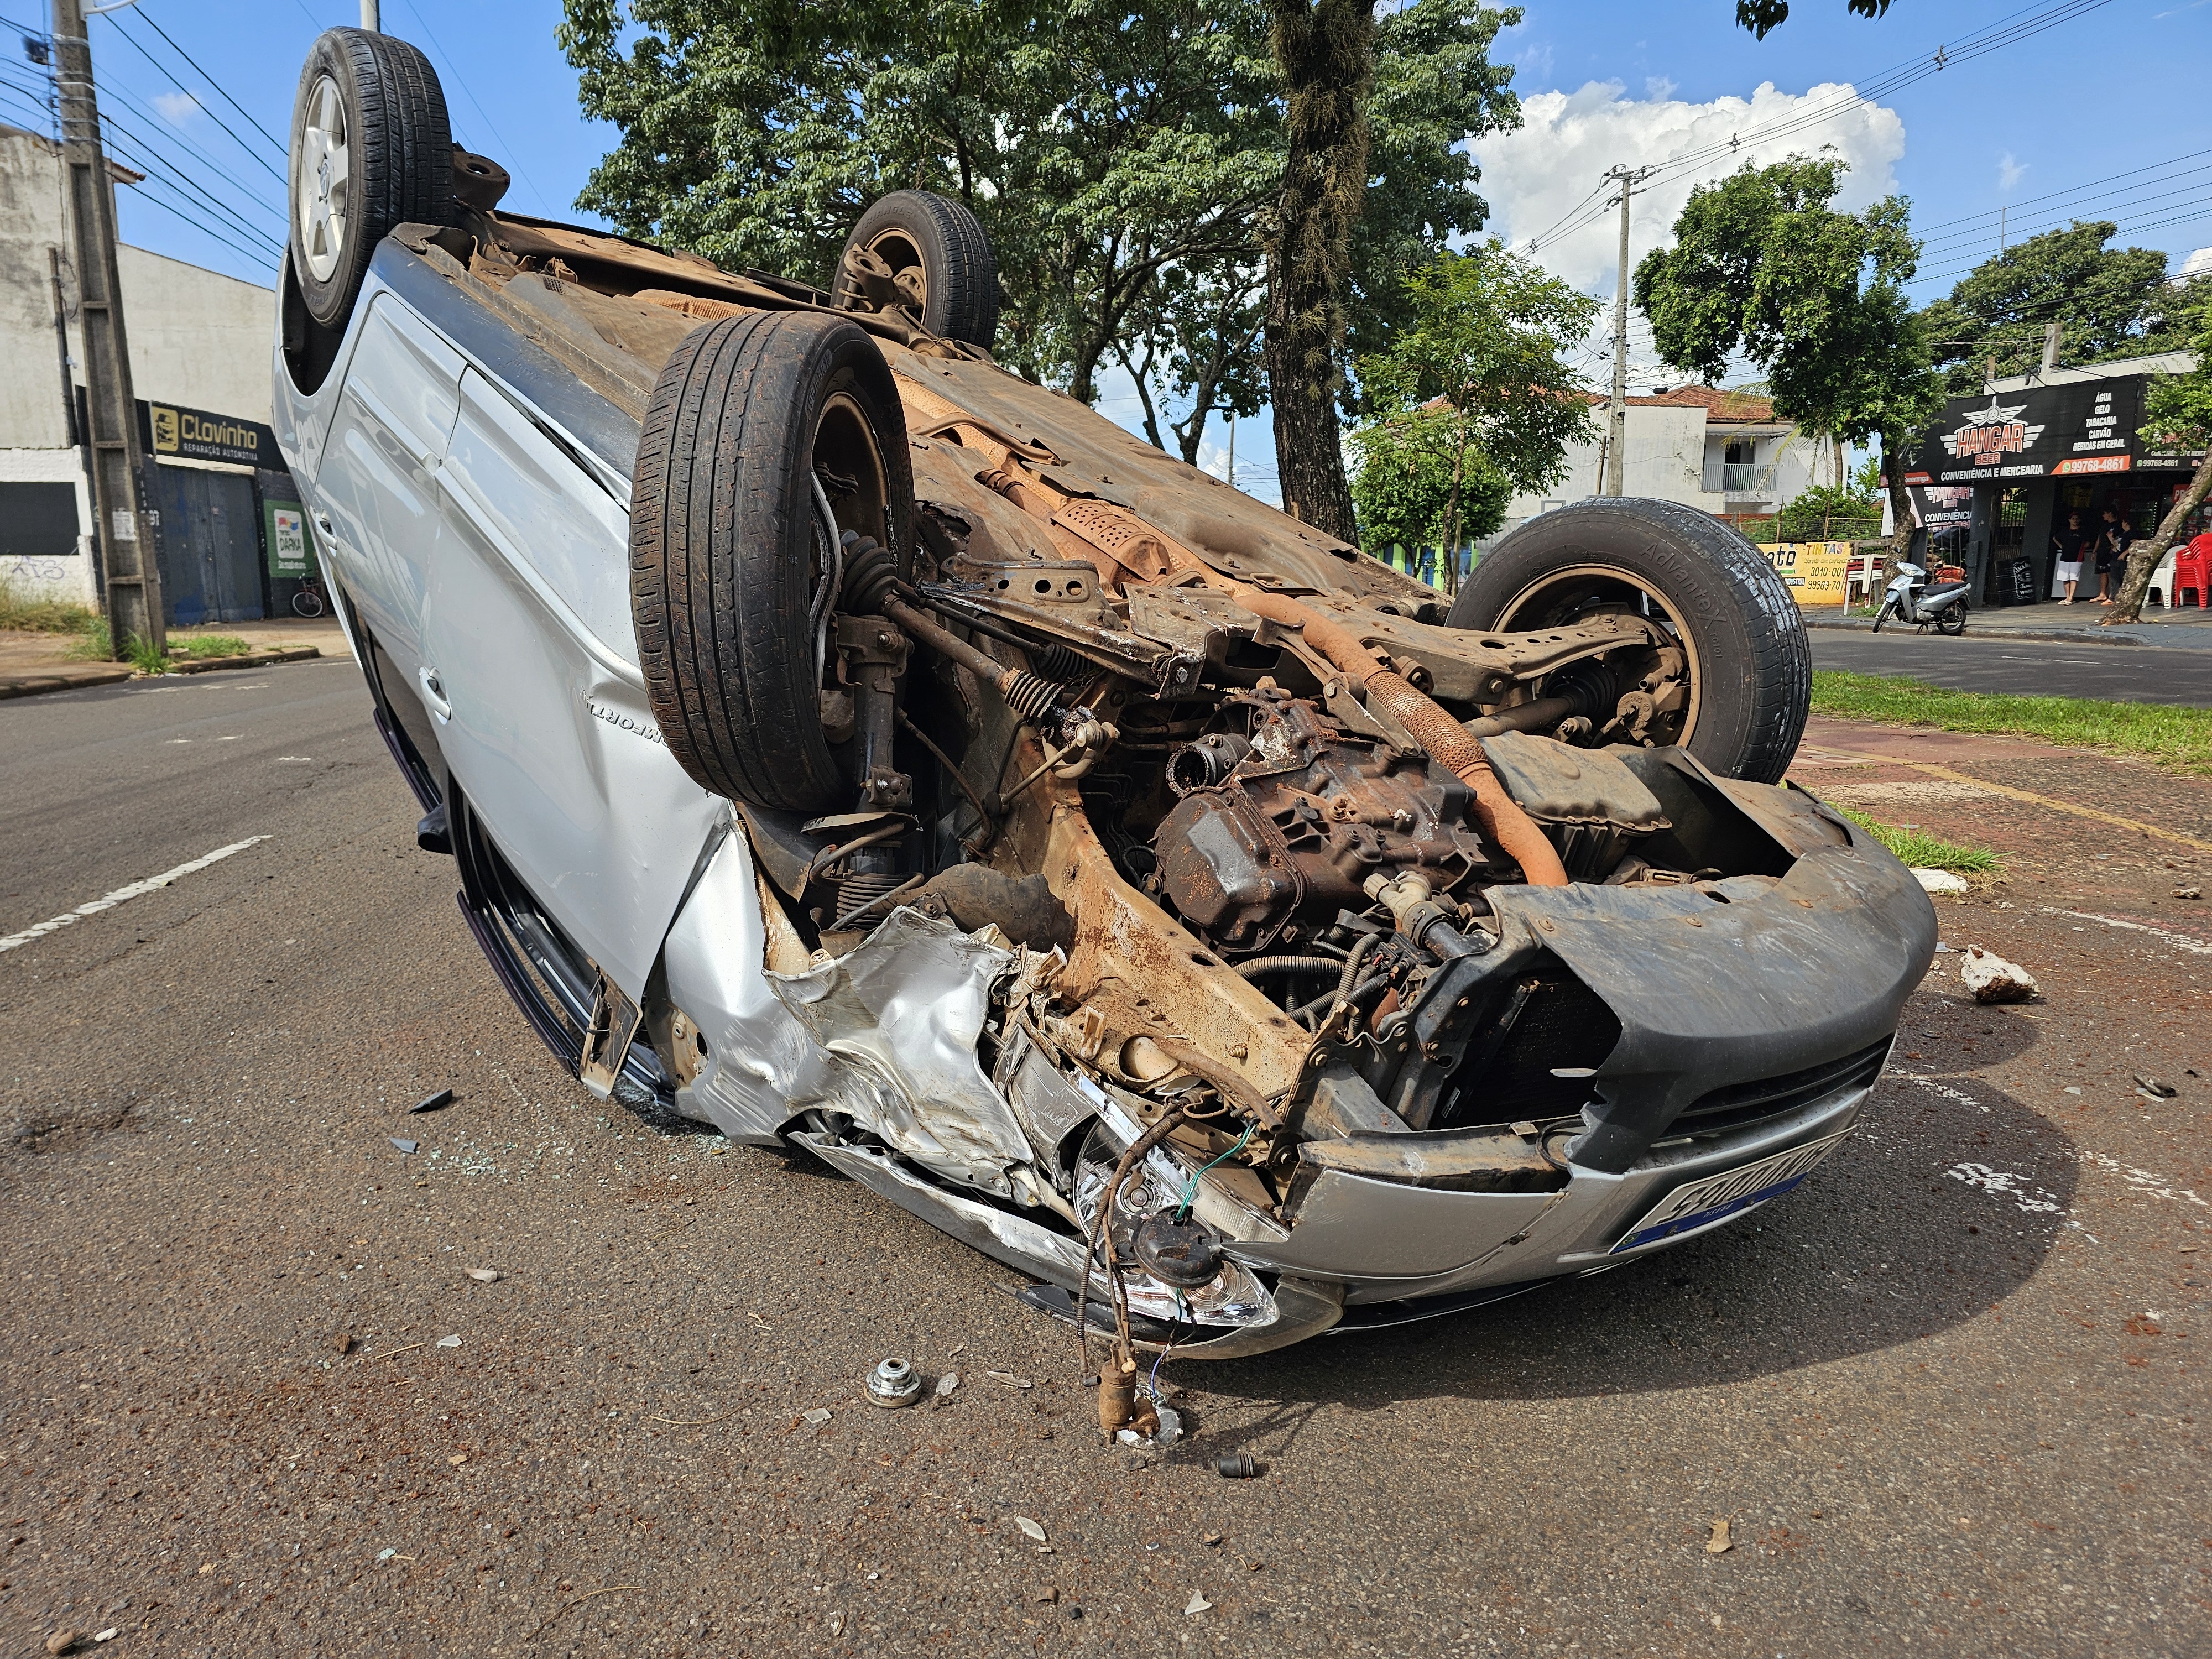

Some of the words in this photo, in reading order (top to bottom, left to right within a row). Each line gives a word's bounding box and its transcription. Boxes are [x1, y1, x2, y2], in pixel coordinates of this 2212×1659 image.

[2095, 392, 2111, 403] ÁGUA
[2094, 404, 2110, 414] GELO
[2086, 416, 2117, 427] TABACARIA
[181, 414, 257, 450] Clovinho
[2088, 427, 2111, 440] CARVÃO
[1956, 424, 2024, 459] HANGAR
[2073, 441, 2096, 451] BEBIDAS
[2096, 440, 2106, 449] EM
[2106, 439, 2125, 448] GERAL
[183, 443, 220, 456] REPARAÇÃO
[222, 448, 258, 461] AUTOMOTIVA
[1975, 452, 2001, 465] BEER
[2071, 457, 2124, 473] 99768-4861
[1940, 467, 1992, 481] CONVENIÊNCIA
[1994, 468, 1999, 477] E
[2000, 465, 2044, 477] MERCEARIA
[1806, 543, 1844, 555] TINTAS
[1703, 1202, 1734, 1218] BRASIL
